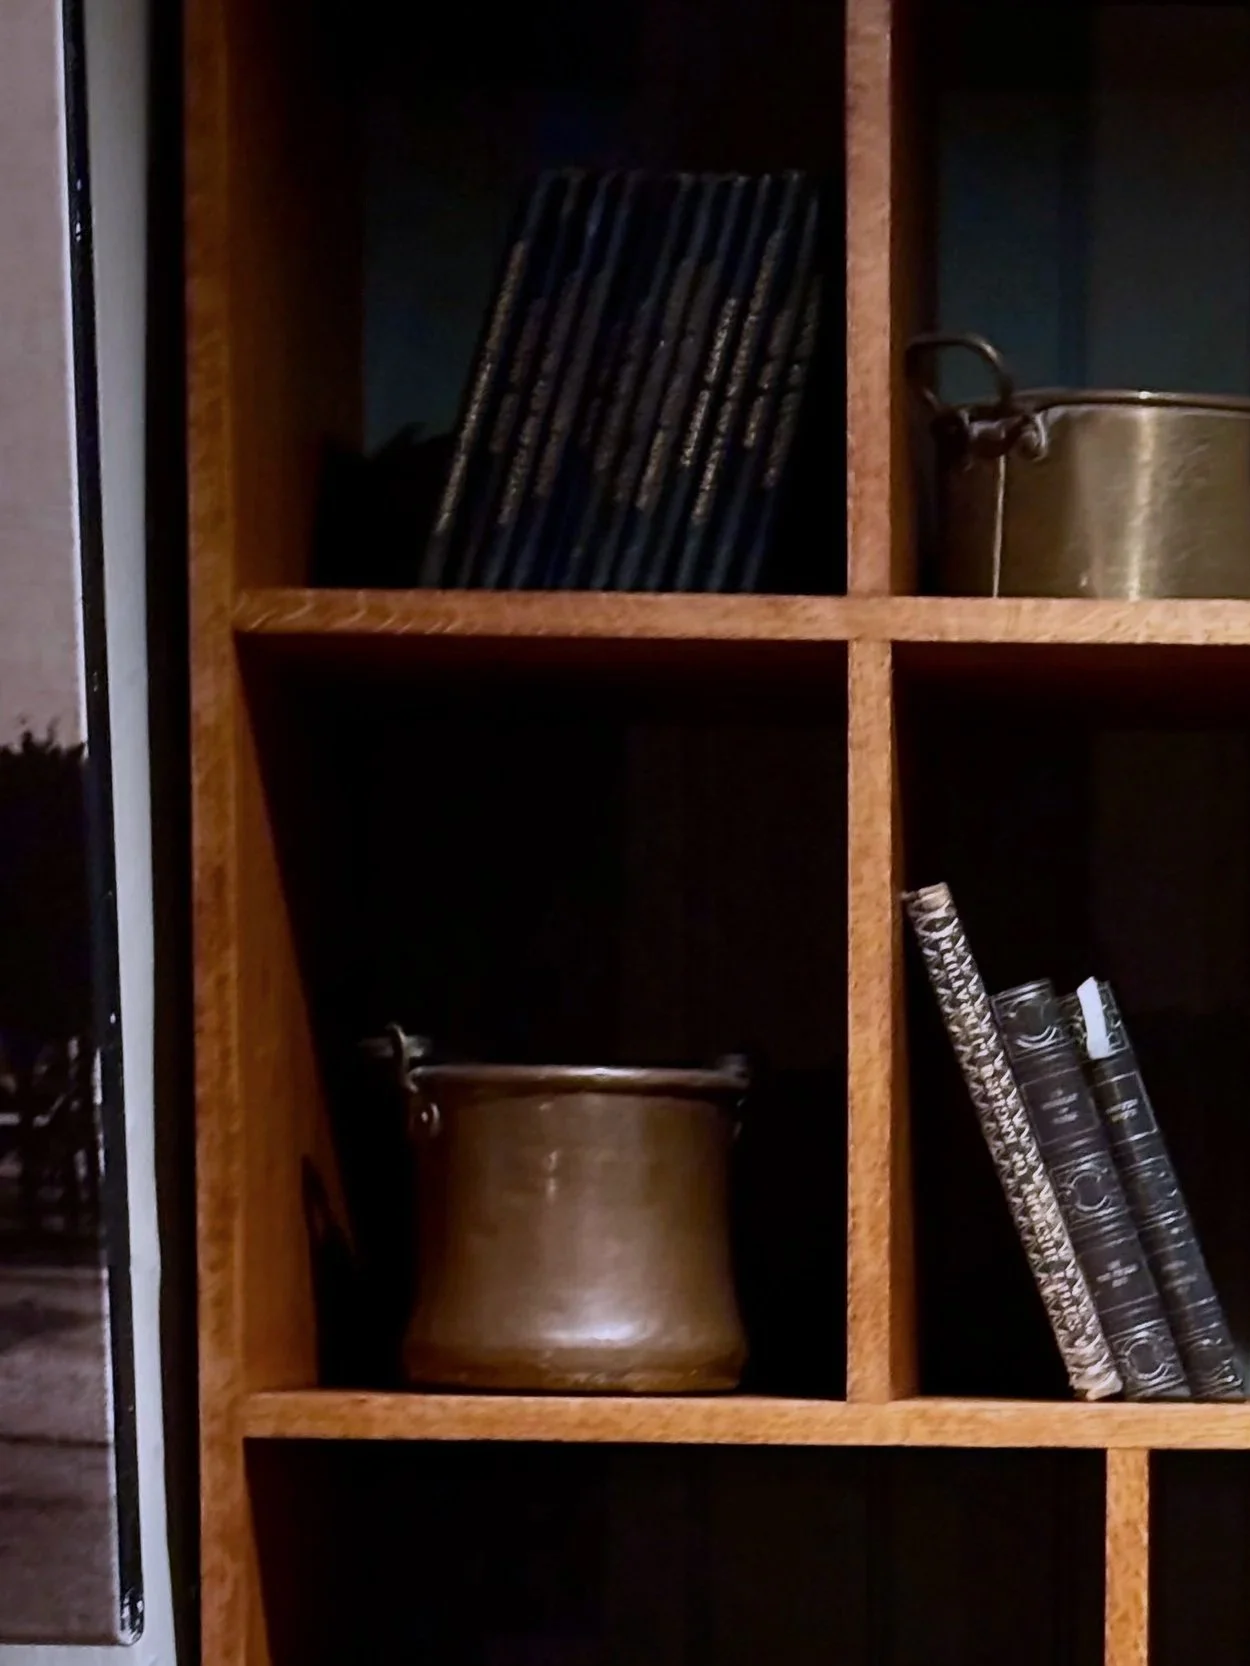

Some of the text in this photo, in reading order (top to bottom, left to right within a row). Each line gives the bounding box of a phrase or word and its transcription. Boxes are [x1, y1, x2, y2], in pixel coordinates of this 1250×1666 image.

[936, 936, 989, 1058] LITERATURE
[978, 1062, 1017, 1145] ENGLISH
[1010, 1149, 1030, 1176] OF
[1020, 1180, 1059, 1263] HISTORY
